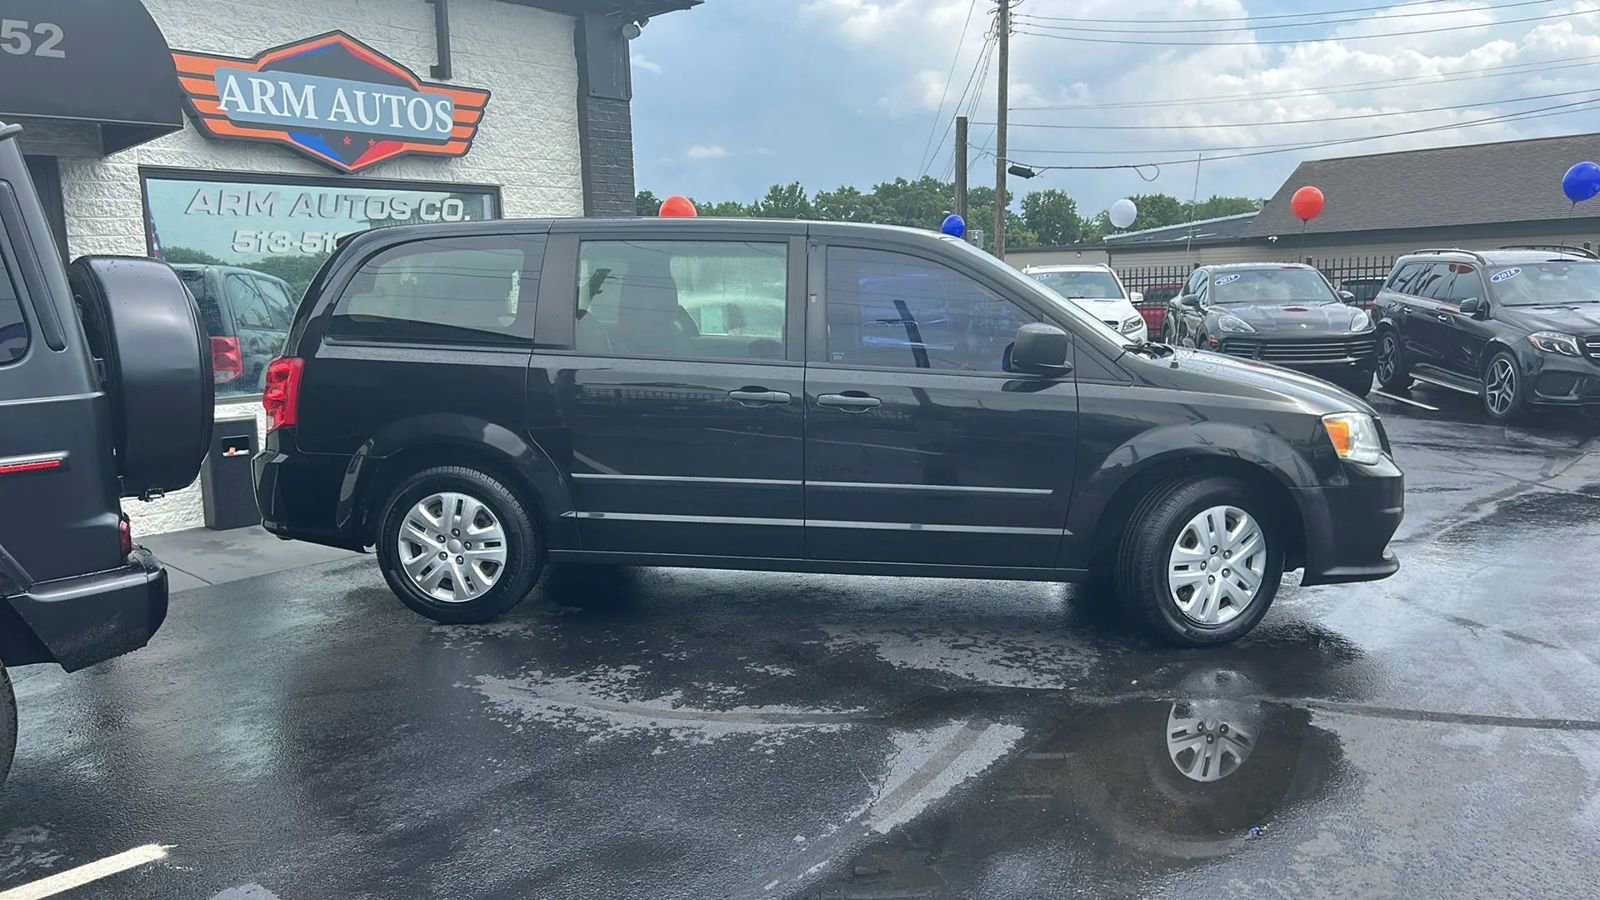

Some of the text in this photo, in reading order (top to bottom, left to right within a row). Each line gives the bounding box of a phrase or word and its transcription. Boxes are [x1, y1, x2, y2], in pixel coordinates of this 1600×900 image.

[0, 19, 66, 58] 52
[216, 74, 454, 133] ARM AUTOS
[184, 188, 470, 221] ARM AUTOS CO.
